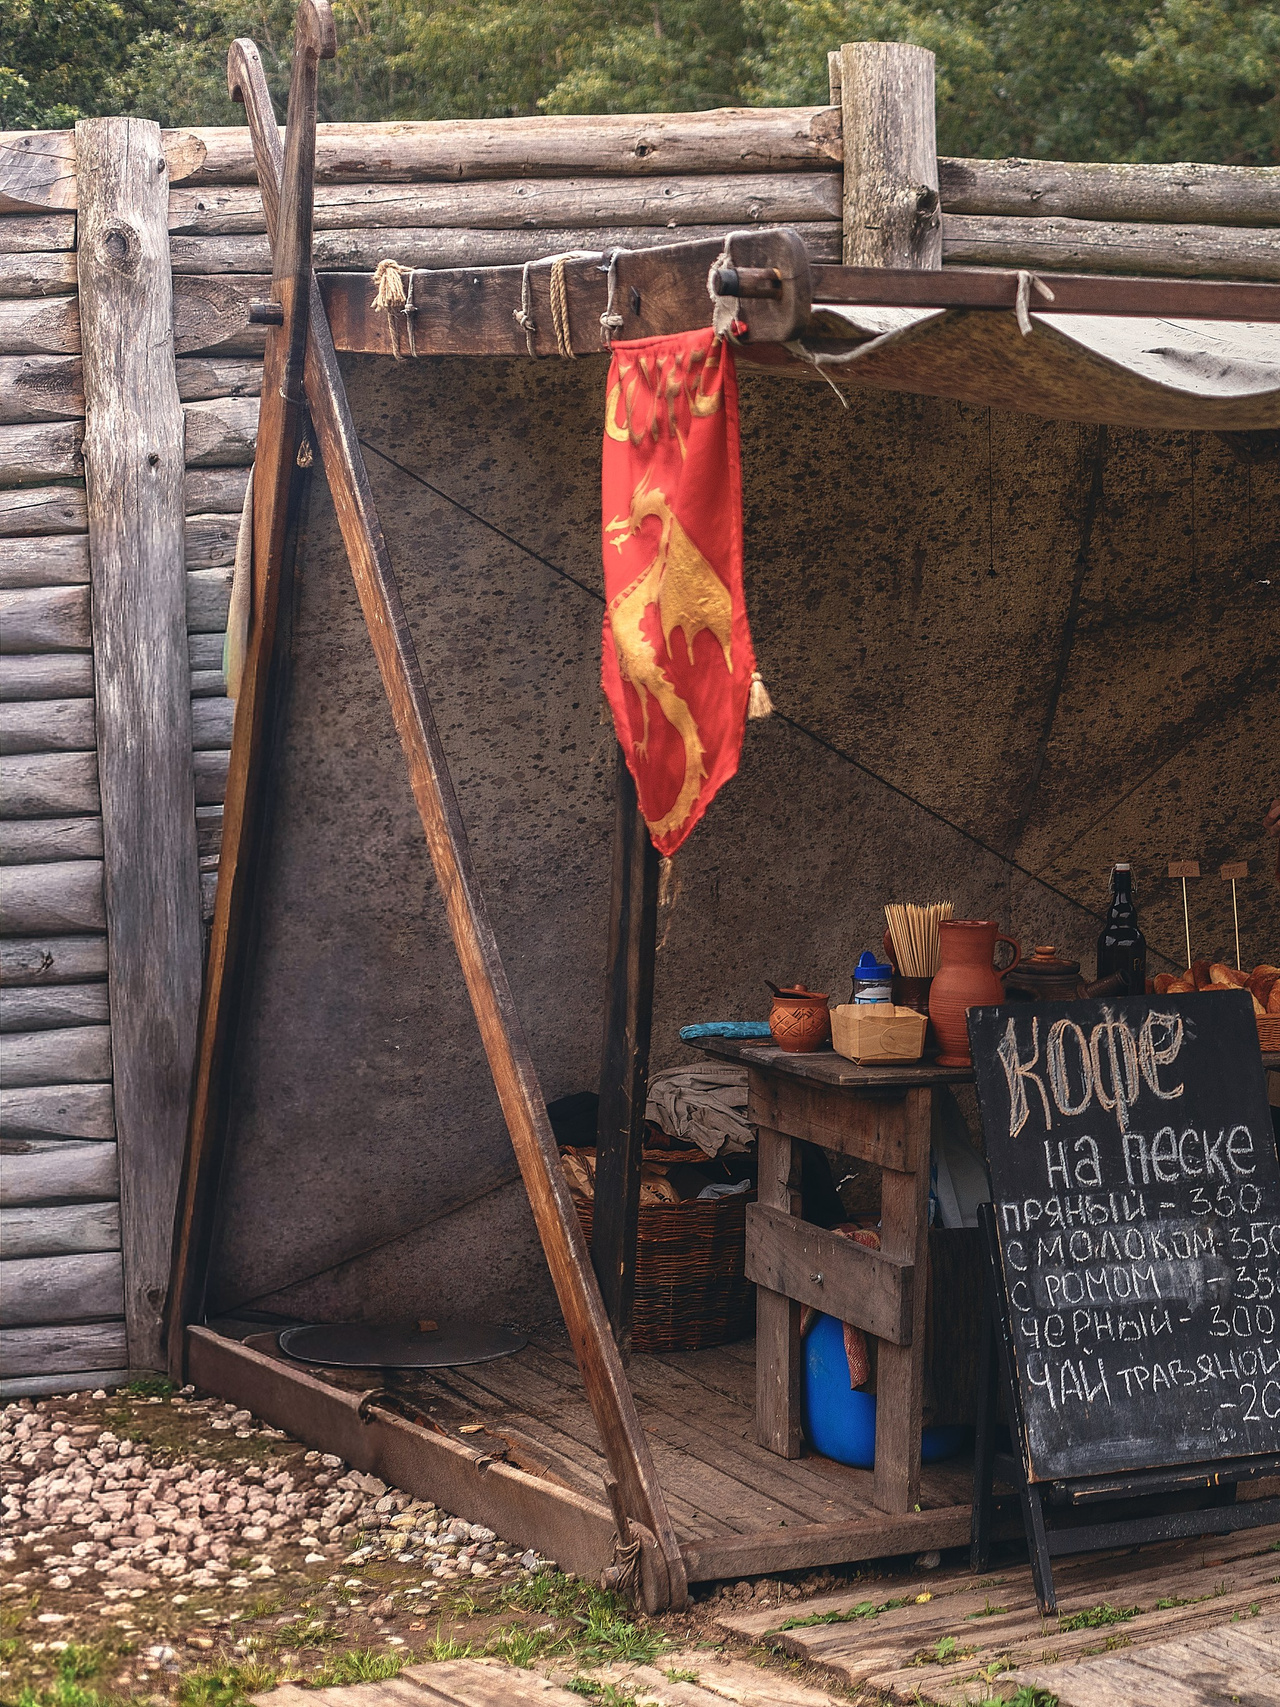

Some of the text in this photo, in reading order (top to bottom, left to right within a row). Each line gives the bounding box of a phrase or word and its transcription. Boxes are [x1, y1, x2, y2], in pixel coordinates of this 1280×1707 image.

[1043, 1125, 1257, 1189] на песке
[1002, 1189, 1147, 1234] ПРЯНЫЙ
[1189, 1183, 1264, 1219] 350
[1046, 1264, 1162, 1307] РОМОМ
[1208, 1304, 1276, 1338] 300
[1026, 1346, 1112, 1409] ЧАЙ
